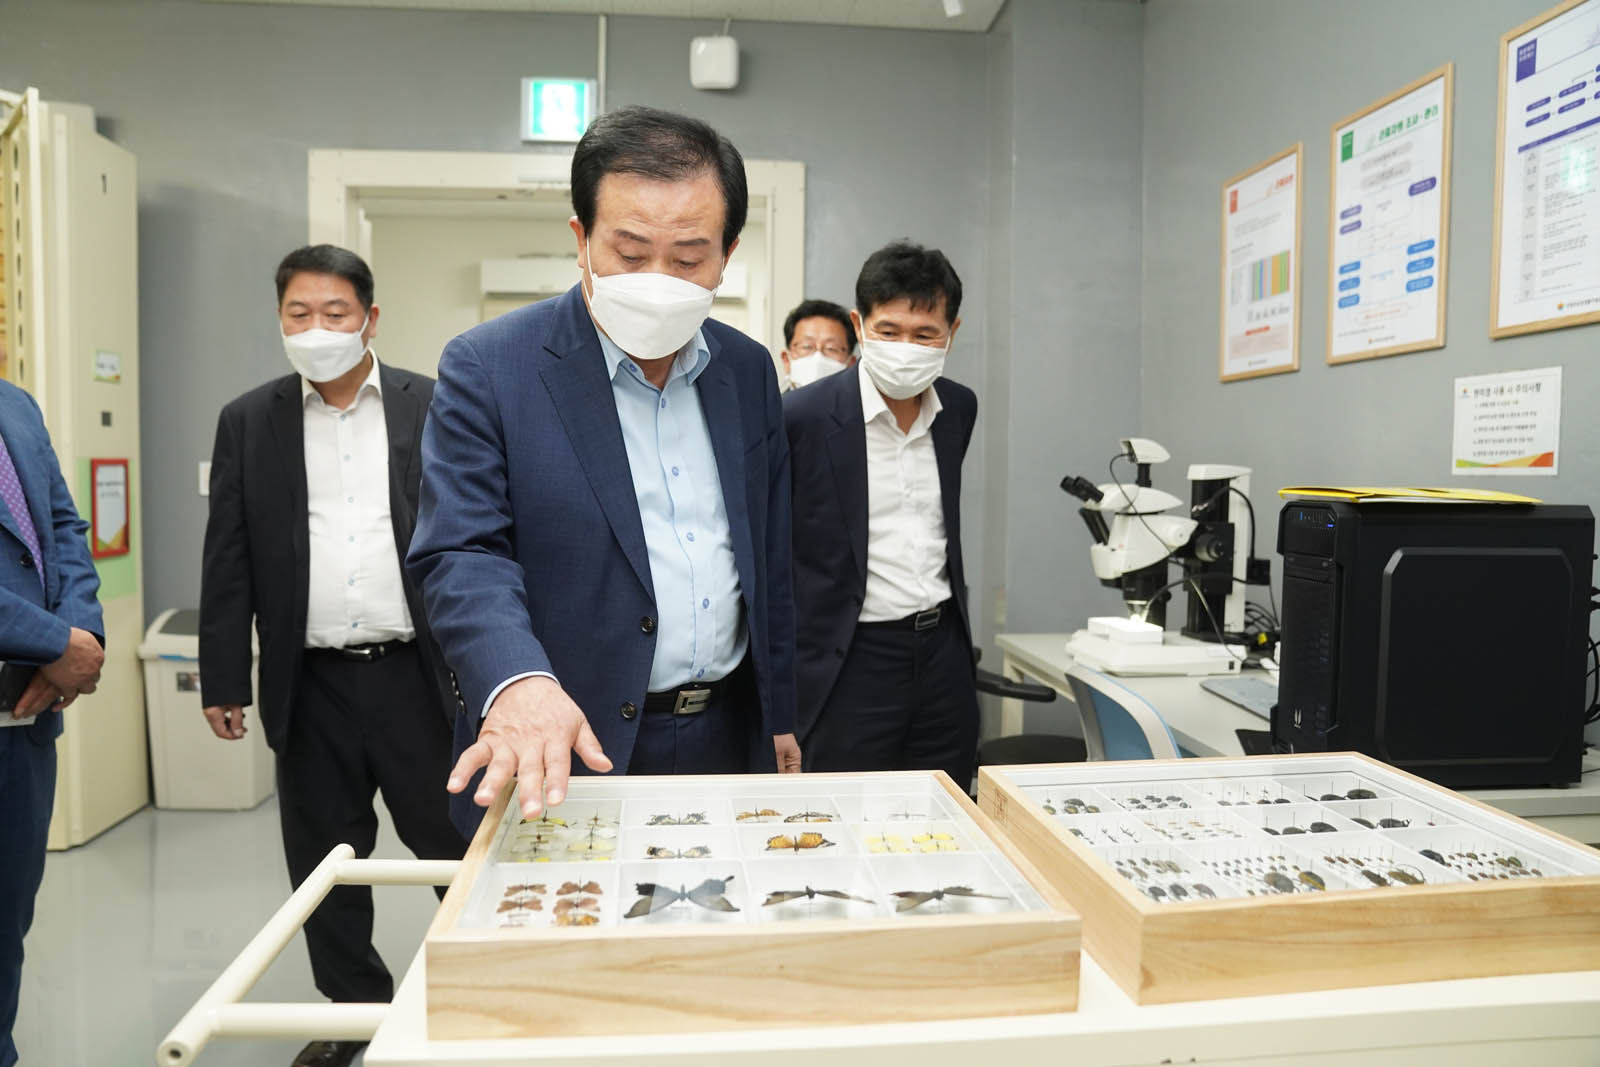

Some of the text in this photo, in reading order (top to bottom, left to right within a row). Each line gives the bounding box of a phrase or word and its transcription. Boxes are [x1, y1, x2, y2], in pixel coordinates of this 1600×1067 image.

[1473, 387, 1491, 399] 현미경
[1493, 385, 1504, 397] 사용
[1515, 382, 1542, 393] 주의사항
